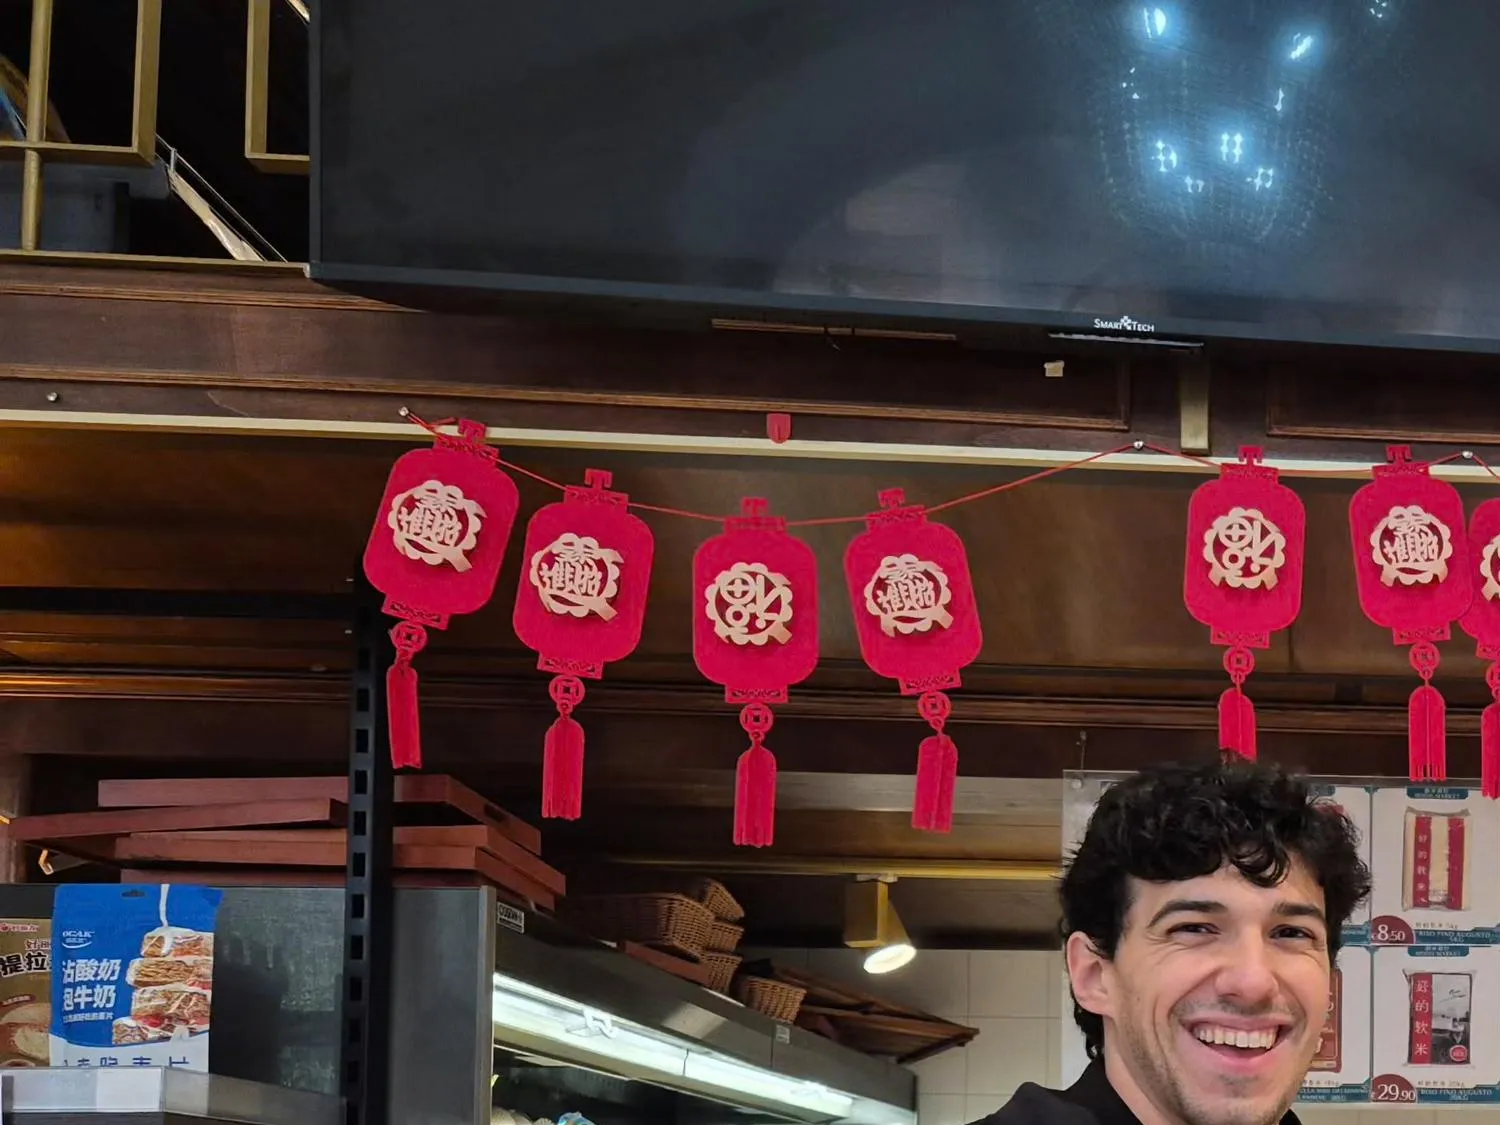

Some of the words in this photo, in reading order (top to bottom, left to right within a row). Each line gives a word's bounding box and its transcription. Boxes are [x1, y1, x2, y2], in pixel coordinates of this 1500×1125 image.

[0, 952, 52, 976] 提拉
[62, 958, 122, 984] 沾酸奶
[63, 985, 117, 1012] 包牛奶
